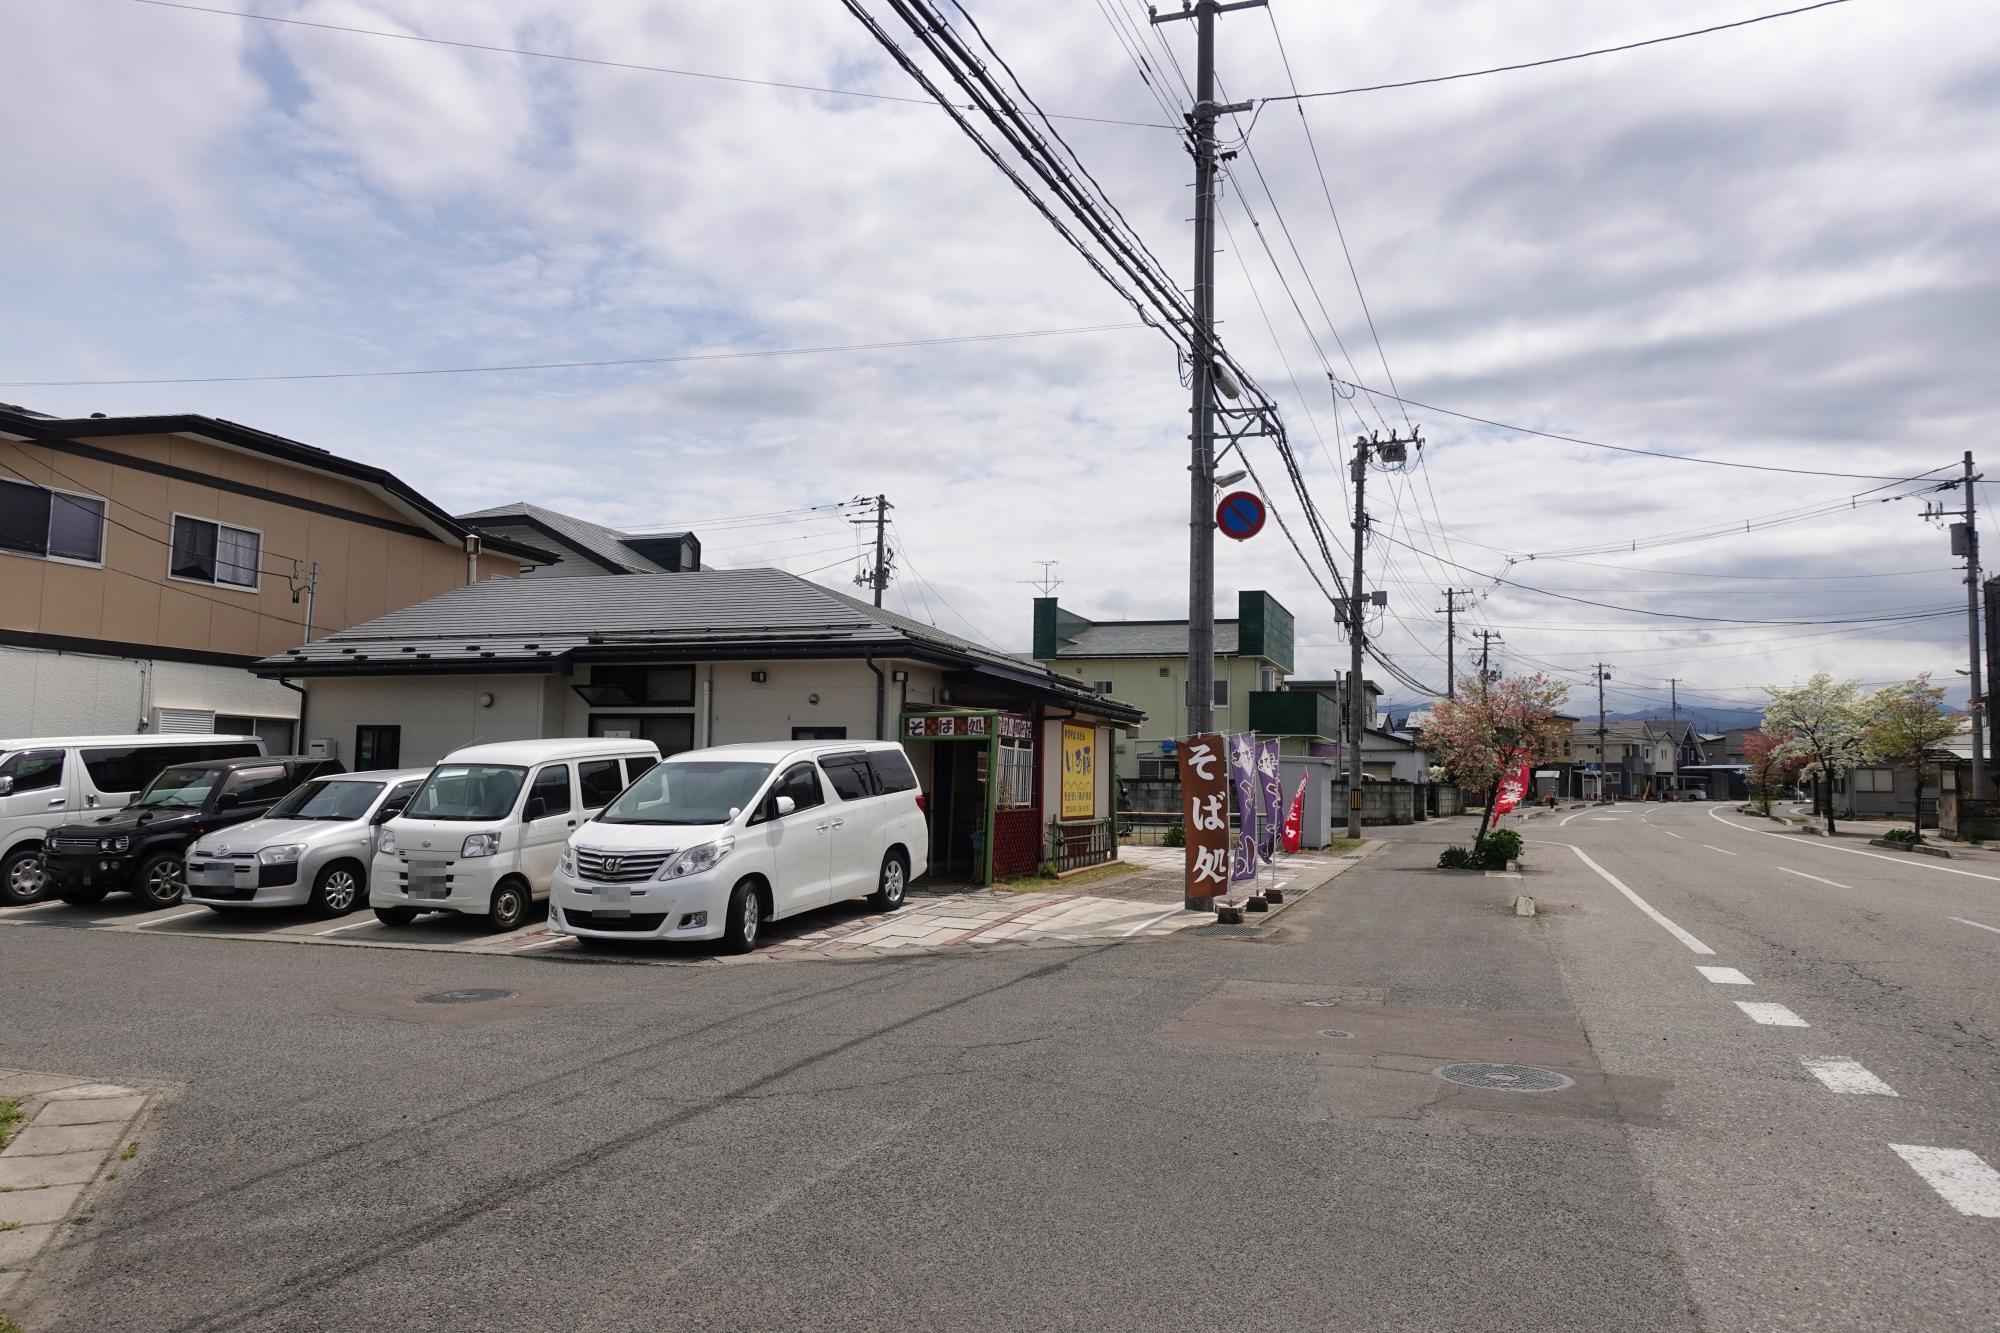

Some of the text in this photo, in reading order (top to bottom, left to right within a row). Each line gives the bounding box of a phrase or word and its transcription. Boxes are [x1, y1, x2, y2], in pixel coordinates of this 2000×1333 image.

[910, 718, 984, 736] そば処
[1187, 743, 1228, 885] そば処
